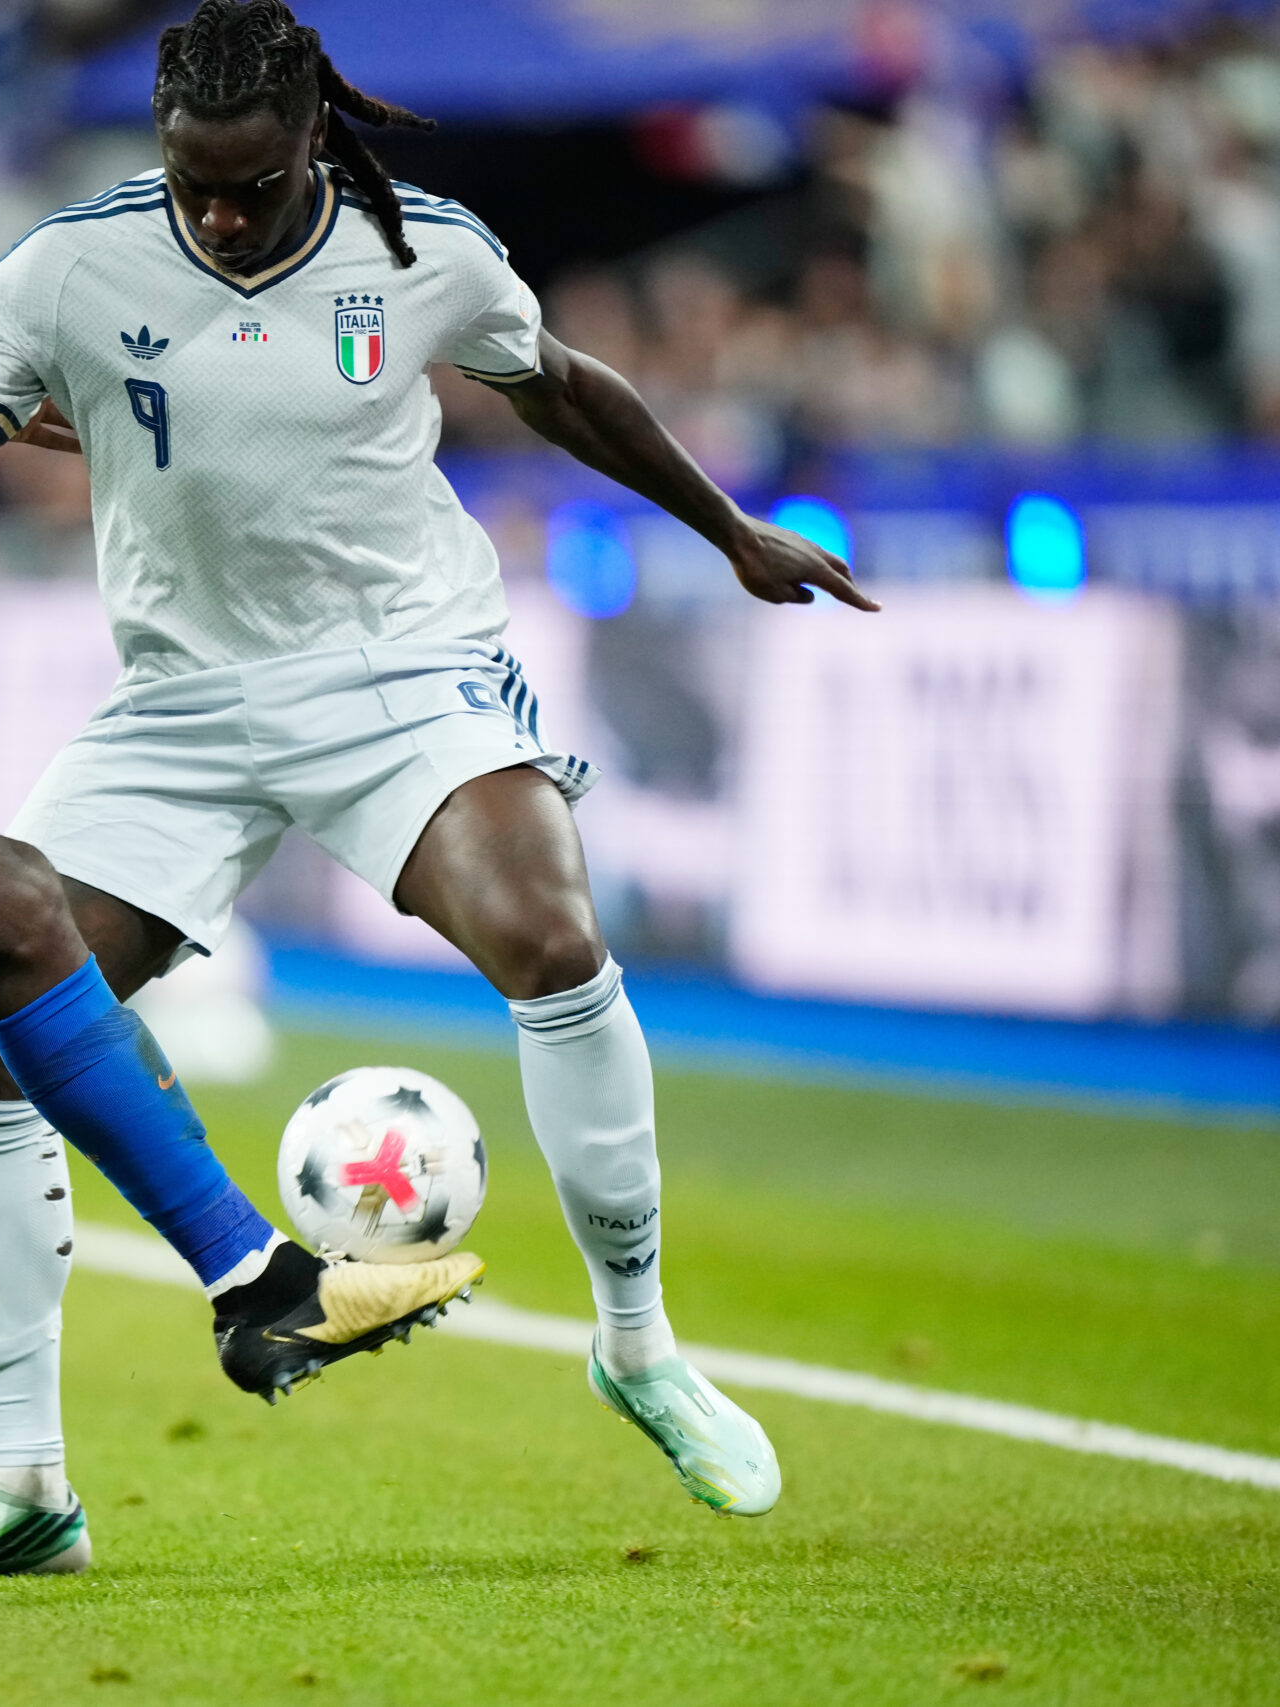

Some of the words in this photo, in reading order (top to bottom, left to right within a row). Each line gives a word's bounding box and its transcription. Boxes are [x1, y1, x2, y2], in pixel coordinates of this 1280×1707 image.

[340, 314, 380, 329] ITALIA
[124, 377, 171, 472] 9
[587, 1207, 658, 1230] ITALIA
